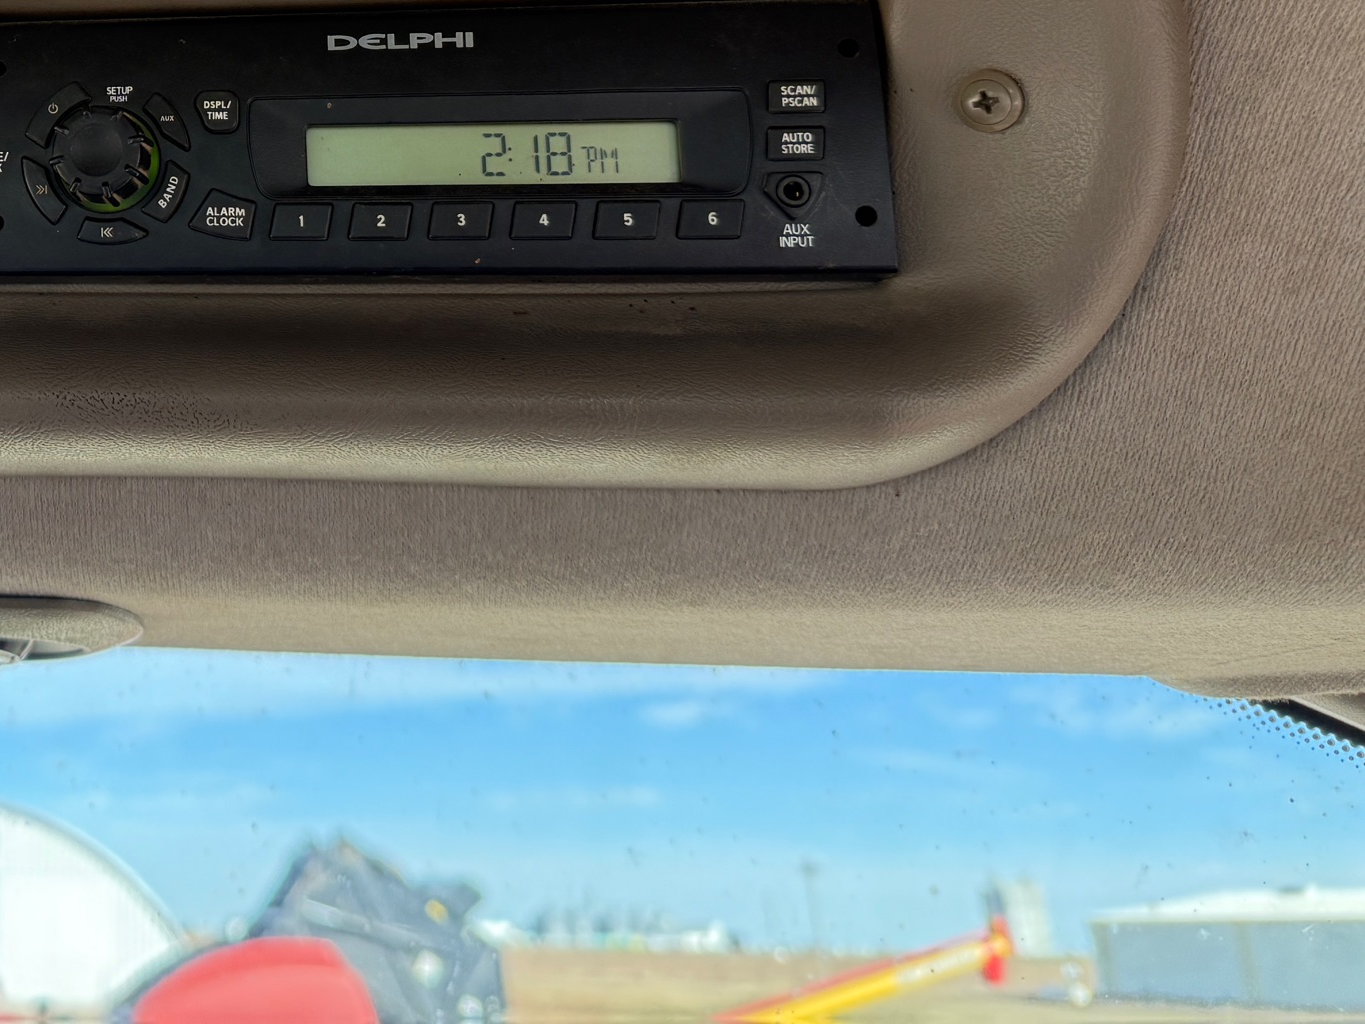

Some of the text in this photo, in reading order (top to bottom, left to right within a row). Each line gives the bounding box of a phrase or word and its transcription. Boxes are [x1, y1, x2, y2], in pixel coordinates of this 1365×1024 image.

[326, 31, 475, 52] DELPHI
[106, 86, 133, 96] SETUP
[780, 84, 817, 96] SCAN/
[109, 95, 128, 103] PUSH
[203, 100, 232, 110] DSPL/
[781, 96, 818, 107] PSCAN
[160, 114, 175, 122] AUX
[206, 111, 229, 121] TIME
[781, 132, 813, 143] AUTO
[481, 132, 620, 177] 2:18 PM
[781, 143, 815, 154] STORE
[157, 174, 180, 209] BAND
[205, 207, 246, 218] ALARM
[707, 211, 718, 225] 6
[206, 216, 245, 227] CLOCK
[297, 214, 305, 228] 1
[376, 214, 386, 227] 2
[457, 213, 466, 227] 3
[538, 213, 549, 226] 4
[623, 213, 633, 226] 5
[782, 223, 811, 235] AUX
[779, 236, 815, 248] INPUT
